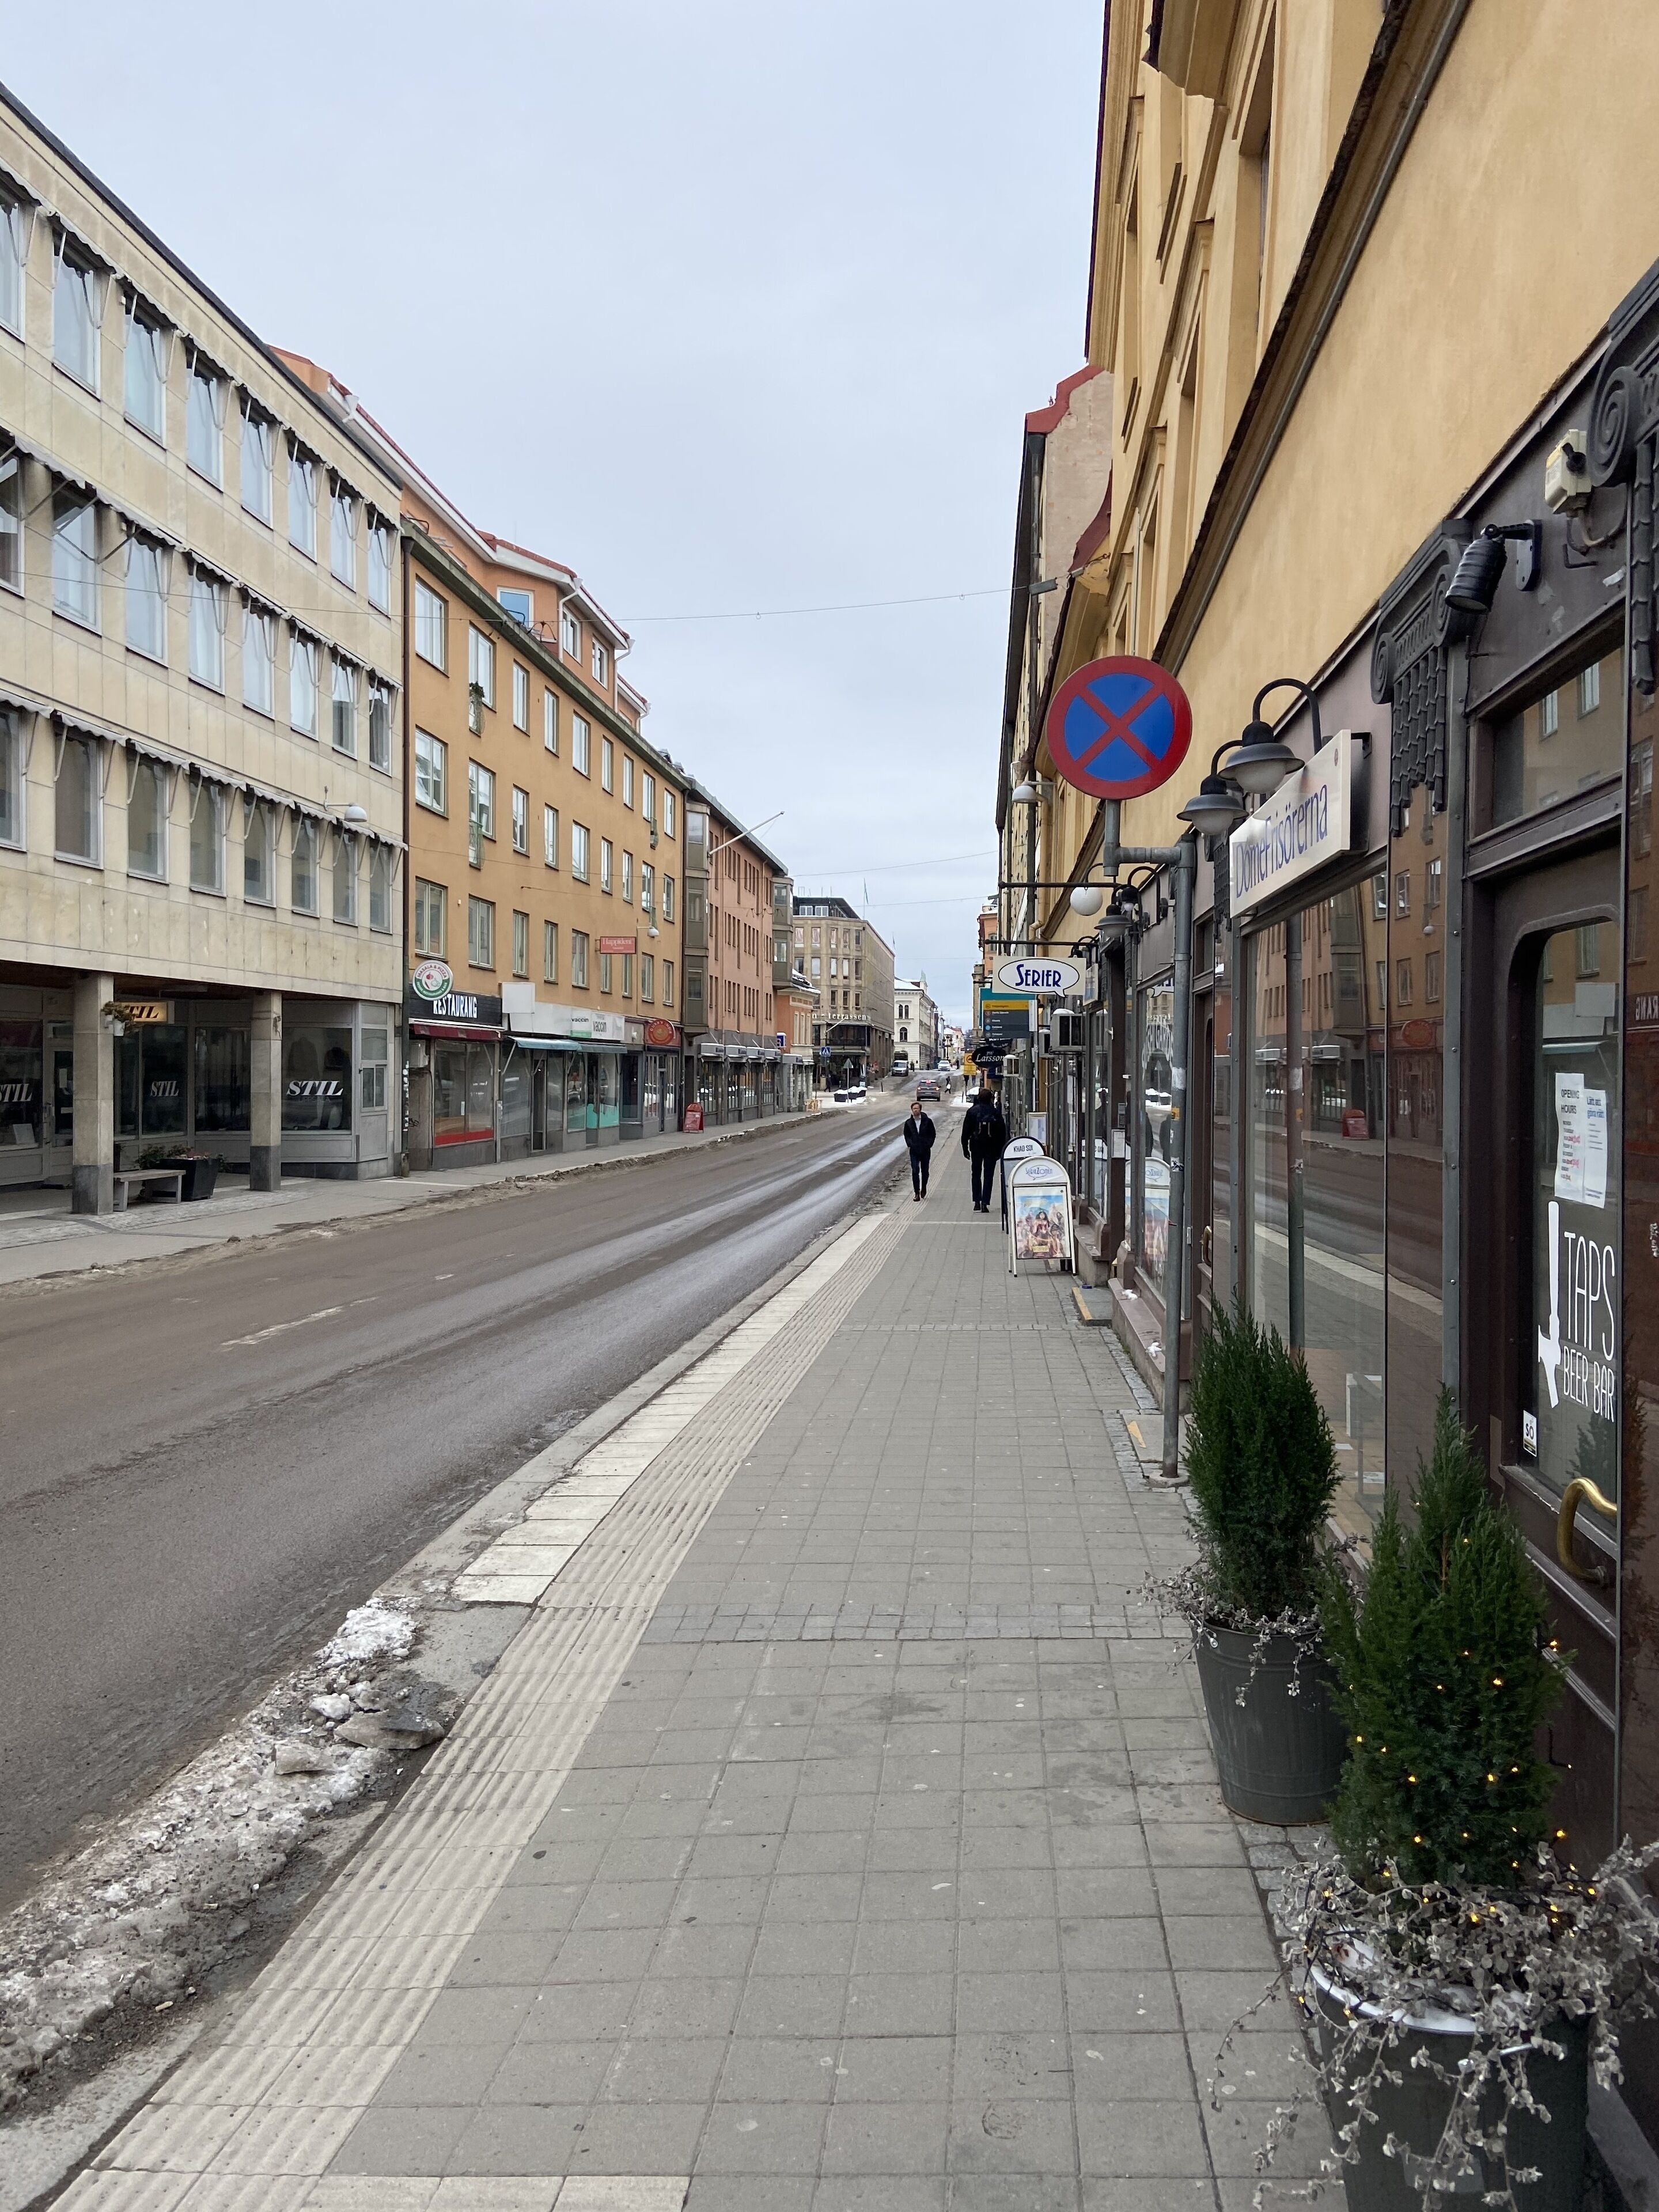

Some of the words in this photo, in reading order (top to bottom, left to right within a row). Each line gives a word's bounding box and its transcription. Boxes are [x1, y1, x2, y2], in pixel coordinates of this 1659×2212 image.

[418, 965, 433, 978] MASALA
[1015, 964, 1062, 987] SERIER
[127, 1006, 159, 1018] TIL
[433, 993, 478, 1018] RESTAURANG
[975, 1054, 1004, 1062] Larsson
[0, 1084, 32, 1102] TIL
[150, 1081, 179, 1097] STIL
[286, 1080, 344, 1096] STIL
[1561, 1089, 1580, 1099] OPENING
[1561, 1105, 1577, 1115] HOURS
[1563, 1231, 1615, 1361] TAPS
[1563, 1346, 1589, 1407] BEER
[1593, 1361, 1615, 1423] BAR
